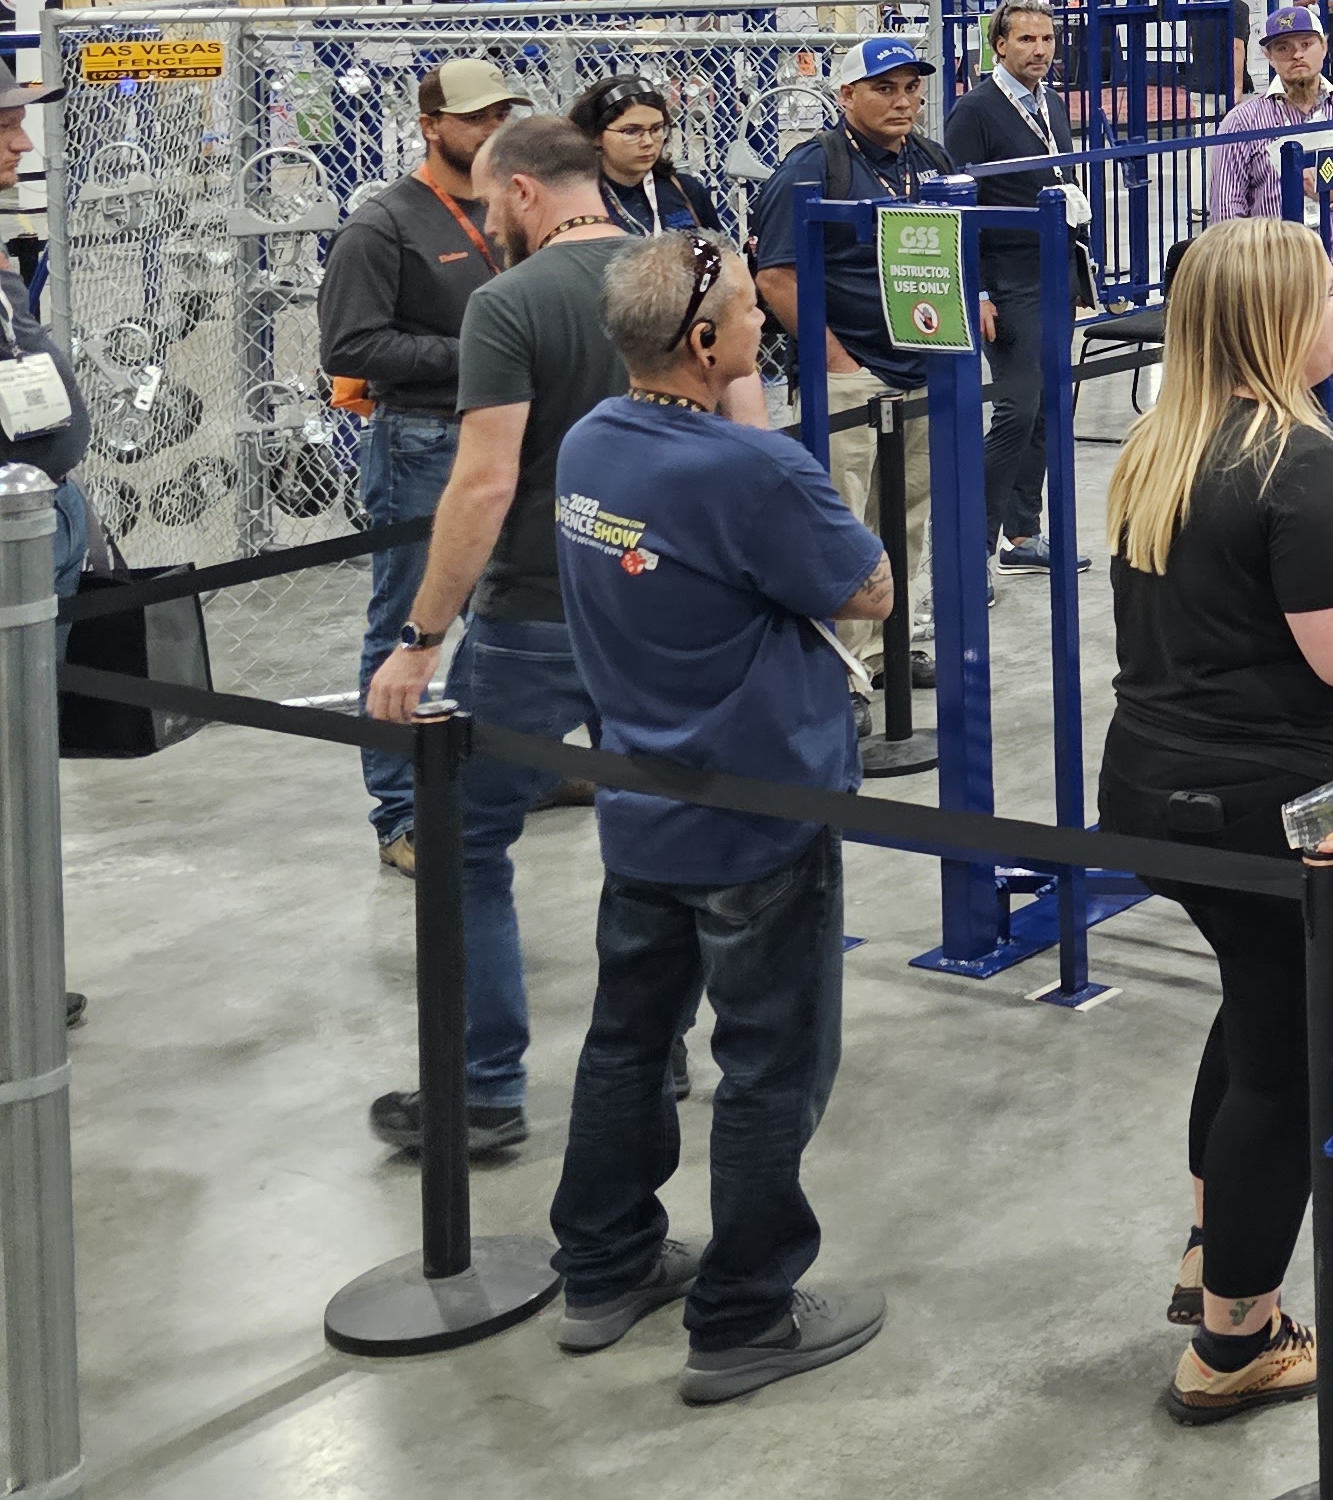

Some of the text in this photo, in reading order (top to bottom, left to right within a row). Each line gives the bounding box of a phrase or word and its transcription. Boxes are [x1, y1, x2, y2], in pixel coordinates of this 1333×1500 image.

[86, 43, 221, 58] LAS VEGAS
[117, 57, 192, 67] FENCE
[900, 225, 940, 249] GSS
[890, 264, 951, 279] INSTRUCTOR
[893, 280, 950, 295] USE ONLY
[560, 506, 644, 549] FENCESHOW
